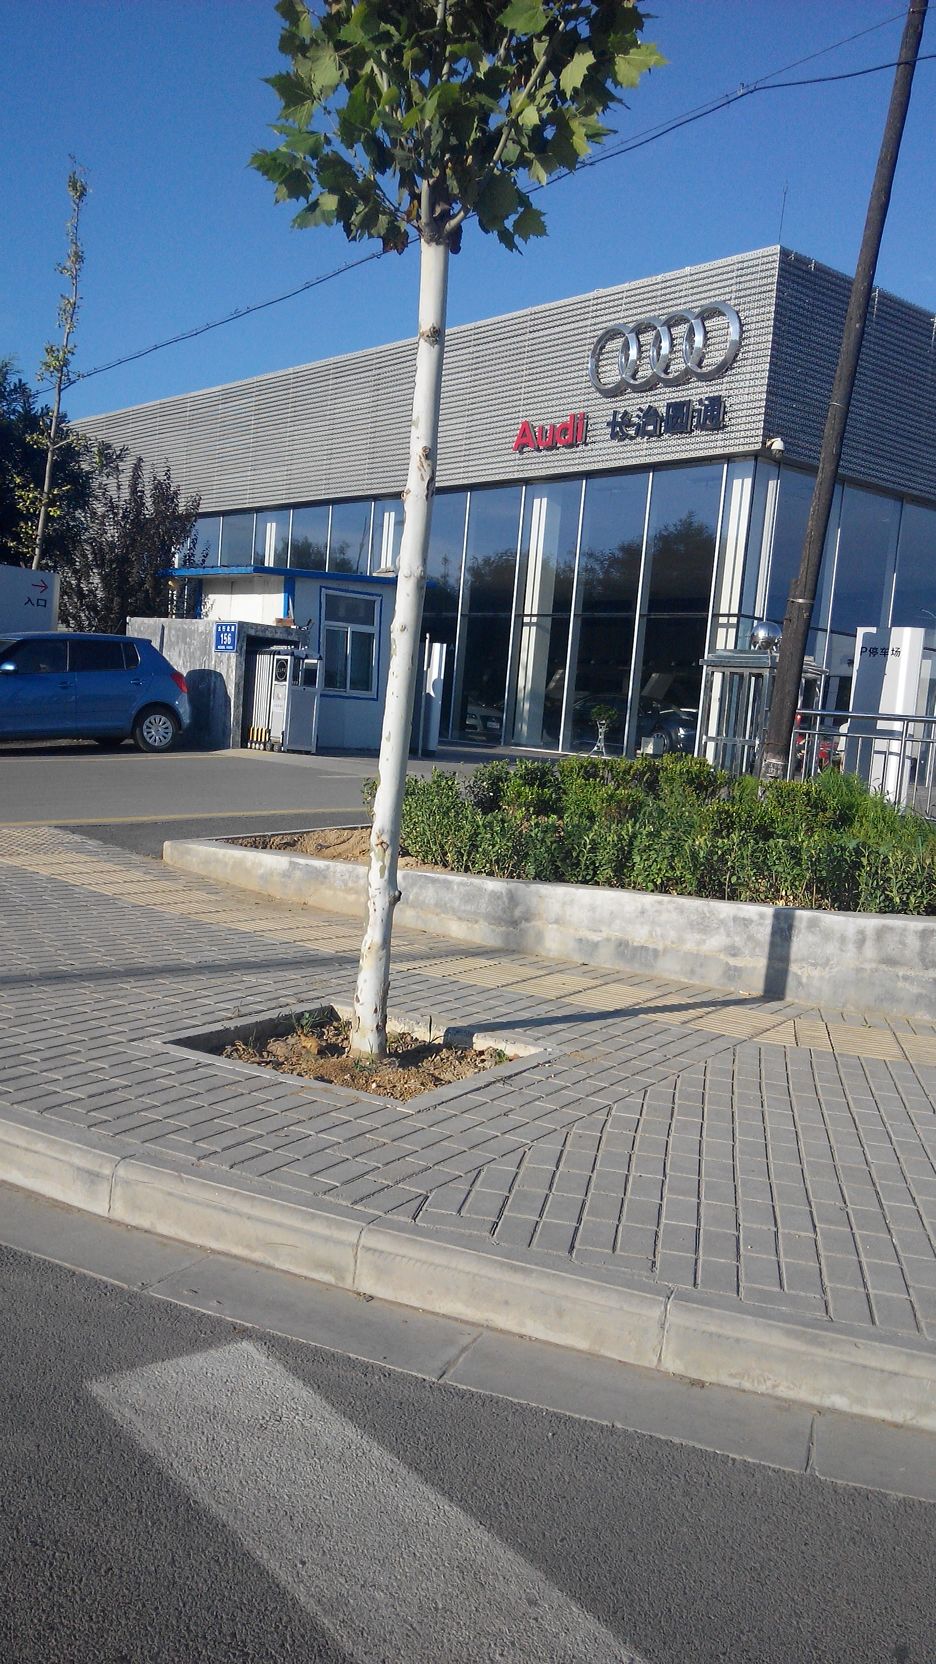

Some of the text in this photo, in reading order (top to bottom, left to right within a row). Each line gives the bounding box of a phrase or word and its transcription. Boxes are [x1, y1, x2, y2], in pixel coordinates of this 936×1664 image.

[512, 411, 586, 450] Audi
[24, 596, 47, 608] 入口
[220, 633, 232, 645] 156
